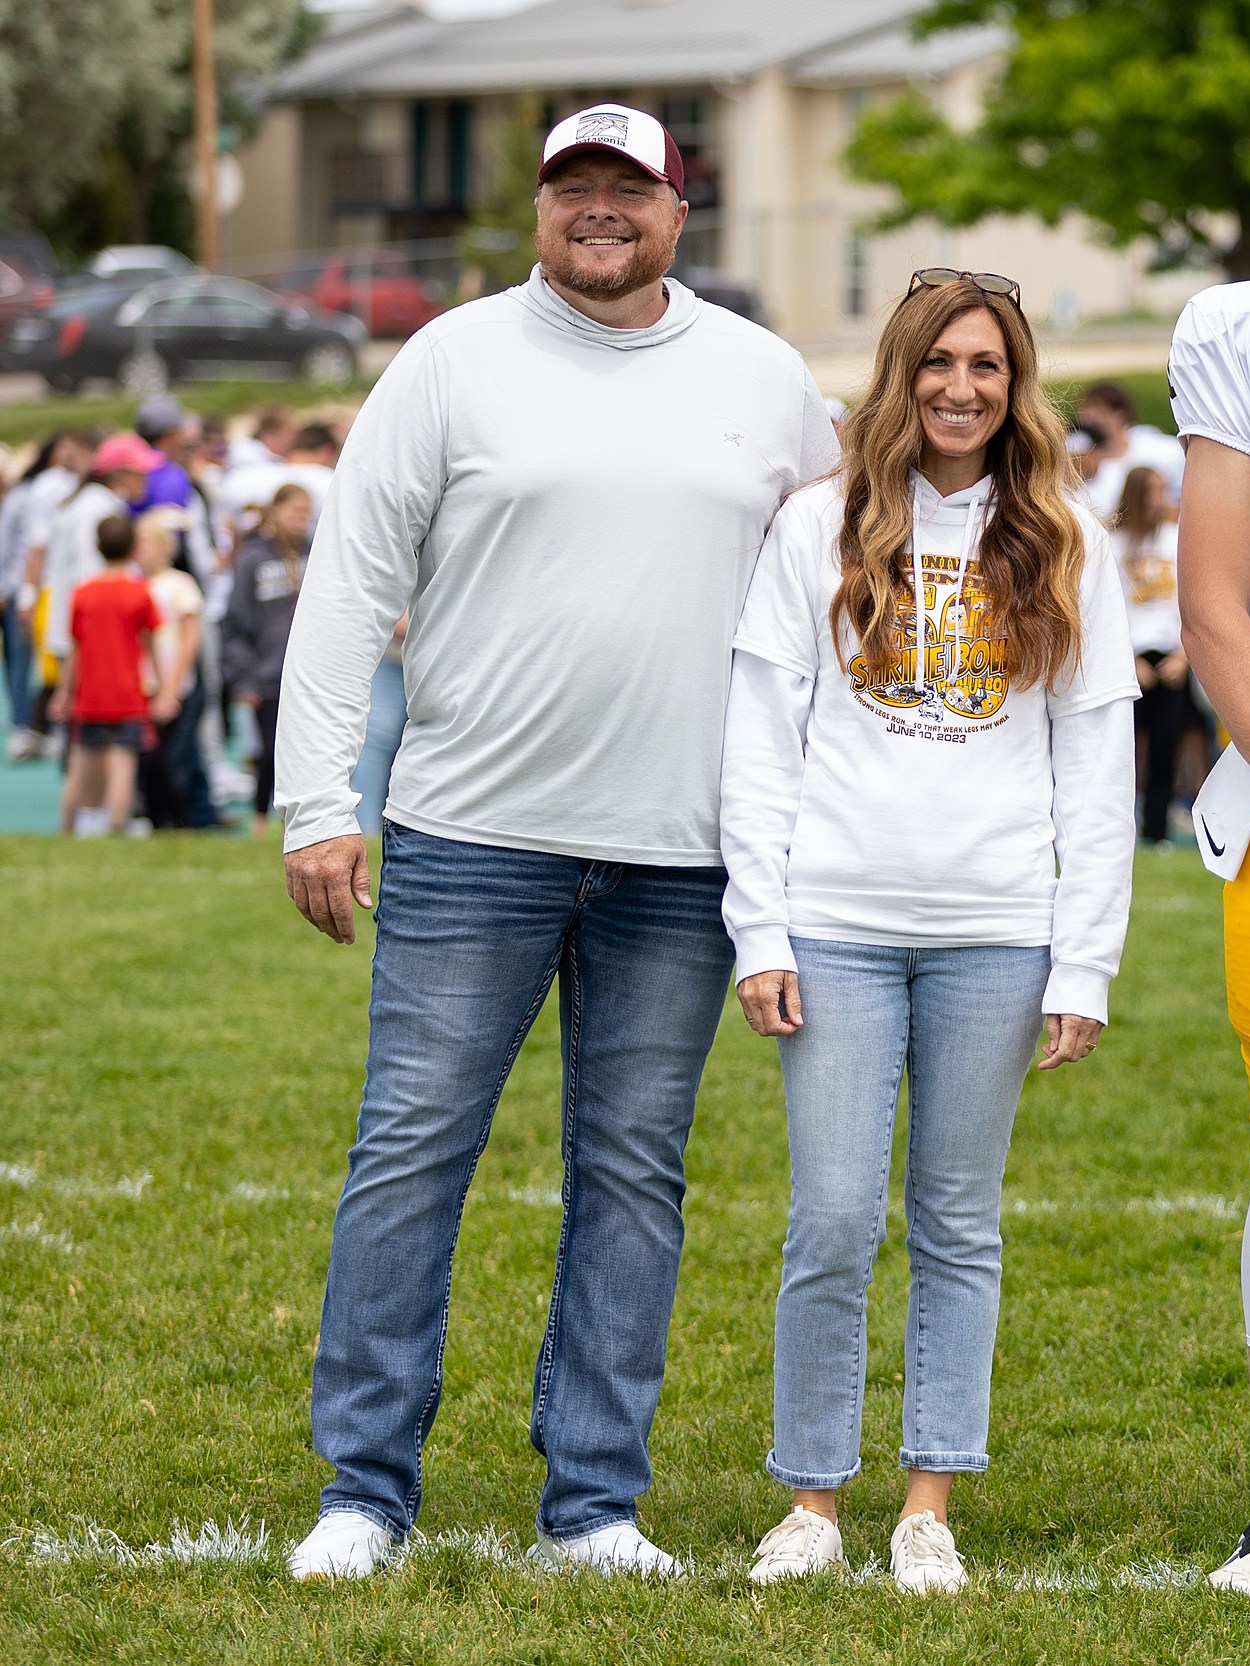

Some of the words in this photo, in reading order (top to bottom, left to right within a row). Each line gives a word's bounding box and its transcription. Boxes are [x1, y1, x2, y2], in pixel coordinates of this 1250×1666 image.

[575, 137, 626, 147] atagonia
[854, 692, 875, 714] STRONG
[875, 707, 890, 720] LEGS
[913, 722, 922, 730] SO
[924, 724, 941, 733] THAT
[943, 725, 963, 734] WEAK
[964, 726, 979, 734] LEGS
[980, 723, 993, 732] MAY
[993, 713, 1010, 728] WALK
[886, 722, 916, 738] JUNE
[918, 730, 935, 742] 10,
[936, 732, 967, 744] 2023
